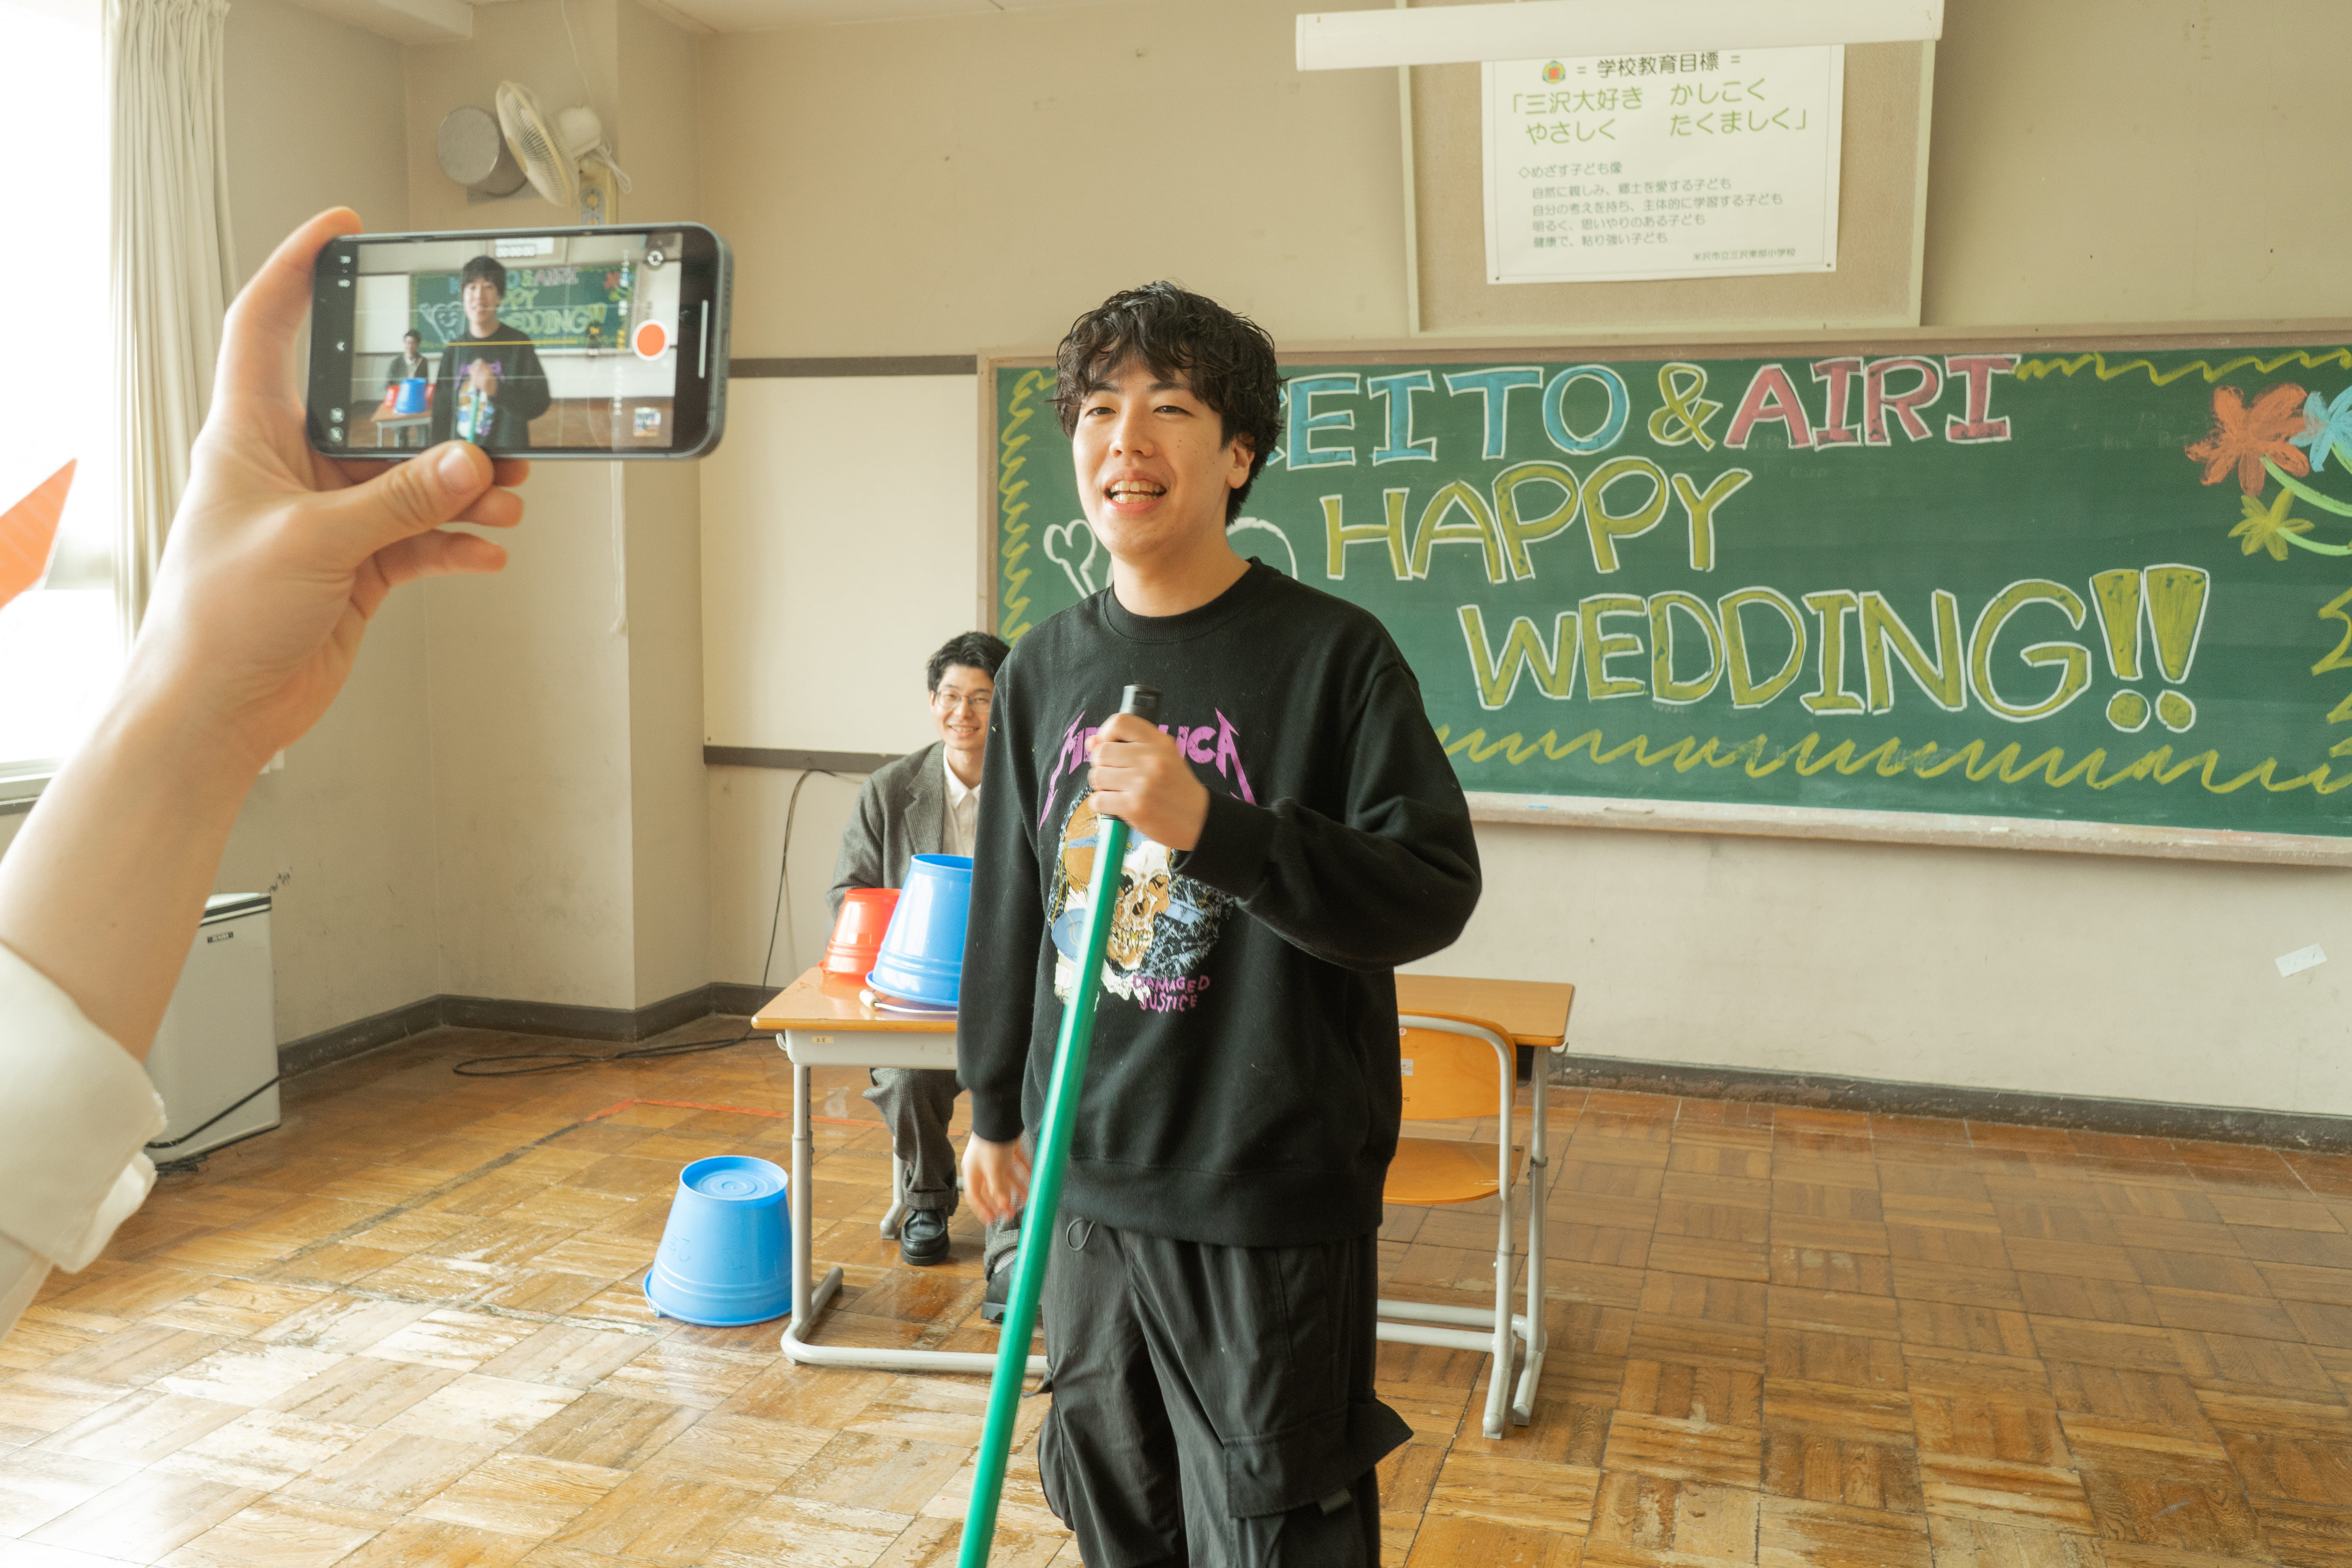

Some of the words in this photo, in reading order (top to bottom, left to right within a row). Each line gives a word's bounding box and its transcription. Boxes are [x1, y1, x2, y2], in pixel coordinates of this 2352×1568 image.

[1597, 51, 1719, 78] 学校教育目標
[1513, 87, 1643, 114] 「三沢大好き
[1670, 78, 1765, 106] かしこく
[1526, 118, 1615, 145] やさしく
[1670, 107, 1806, 136] たくましく」
[1268, 364, 1630, 470] EITO
[1724, 354, 2022, 452] AIRI
[1319, 456, 1753, 584] HAPPY
[1457, 563, 2210, 733] WEDDING!!
[1133, 974, 1211, 993] DAMAGED
[1139, 991, 1198, 1014] JUSTICE
